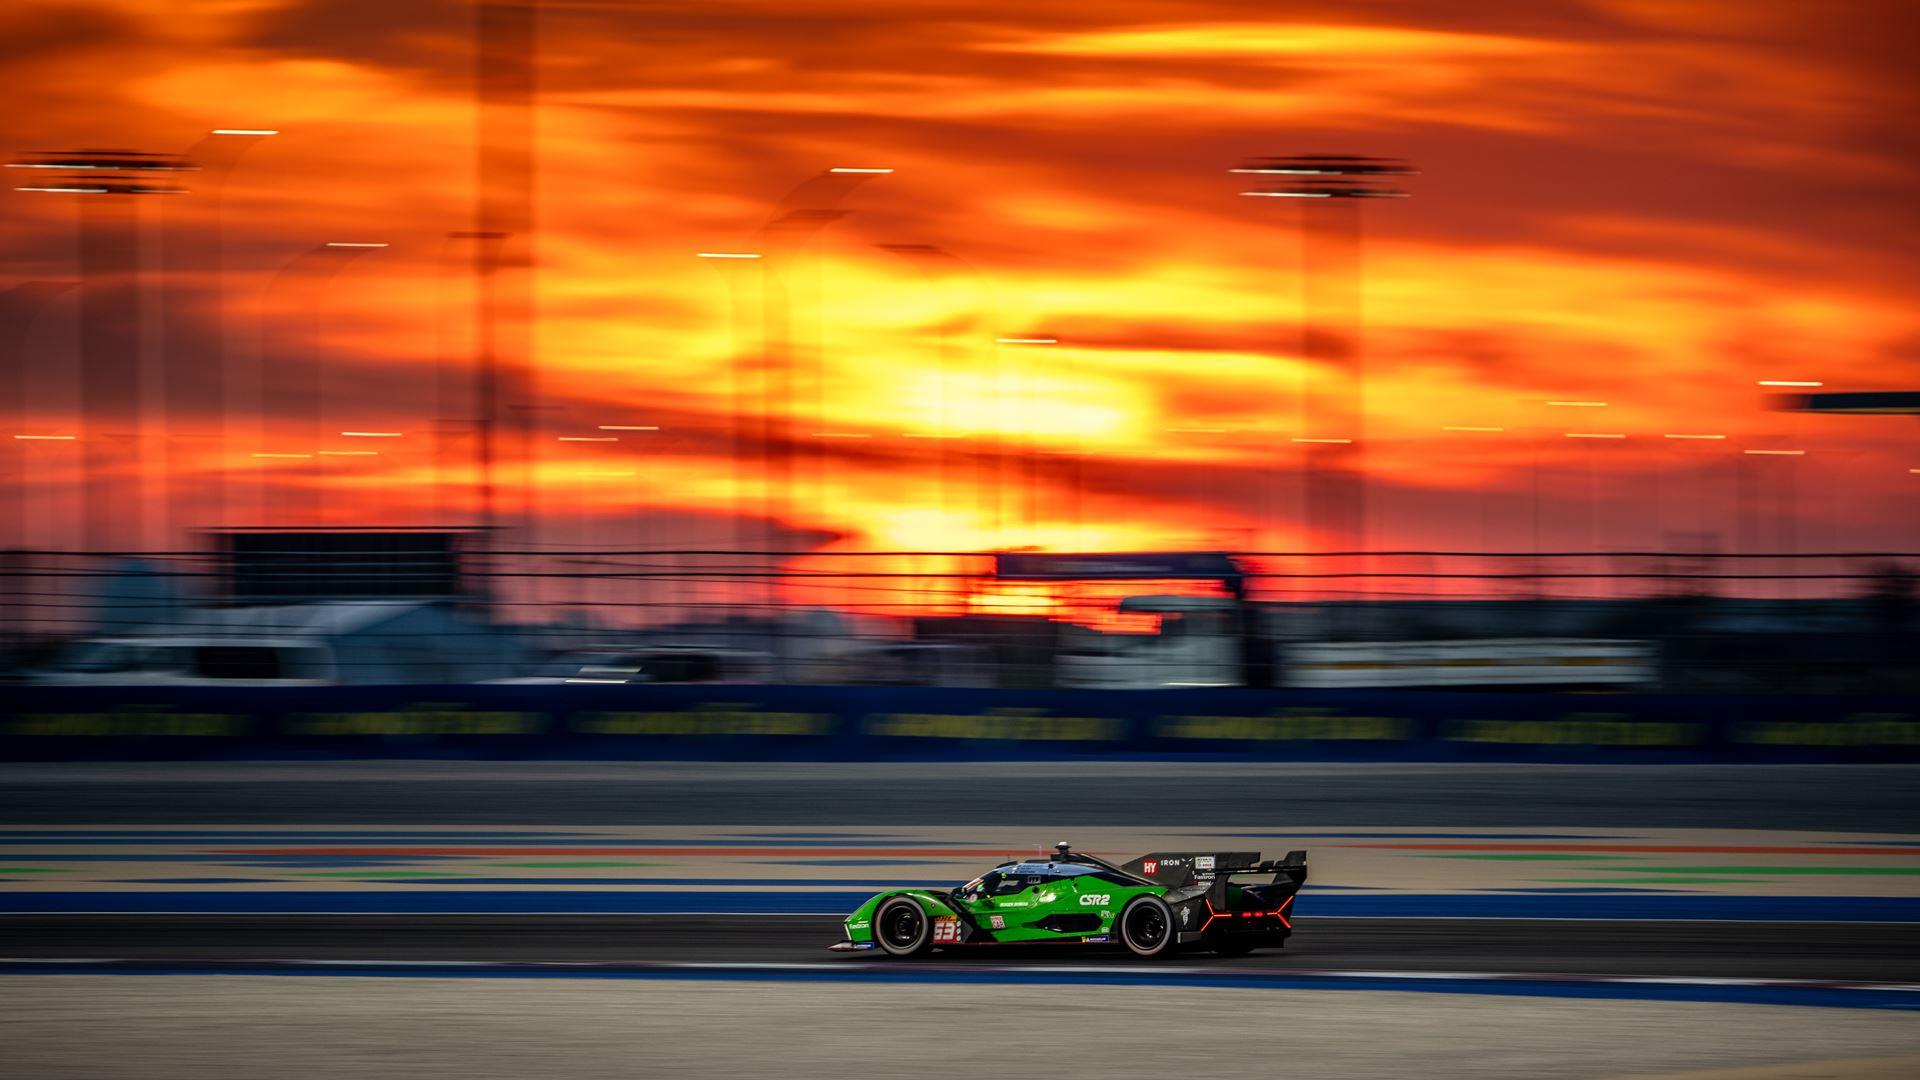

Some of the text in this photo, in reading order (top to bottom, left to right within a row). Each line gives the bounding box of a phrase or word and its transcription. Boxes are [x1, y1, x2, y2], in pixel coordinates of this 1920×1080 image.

[1144, 862, 1157, 873] HY
[1079, 894, 1111, 906] CSR2
[933, 922, 956, 940] 63
